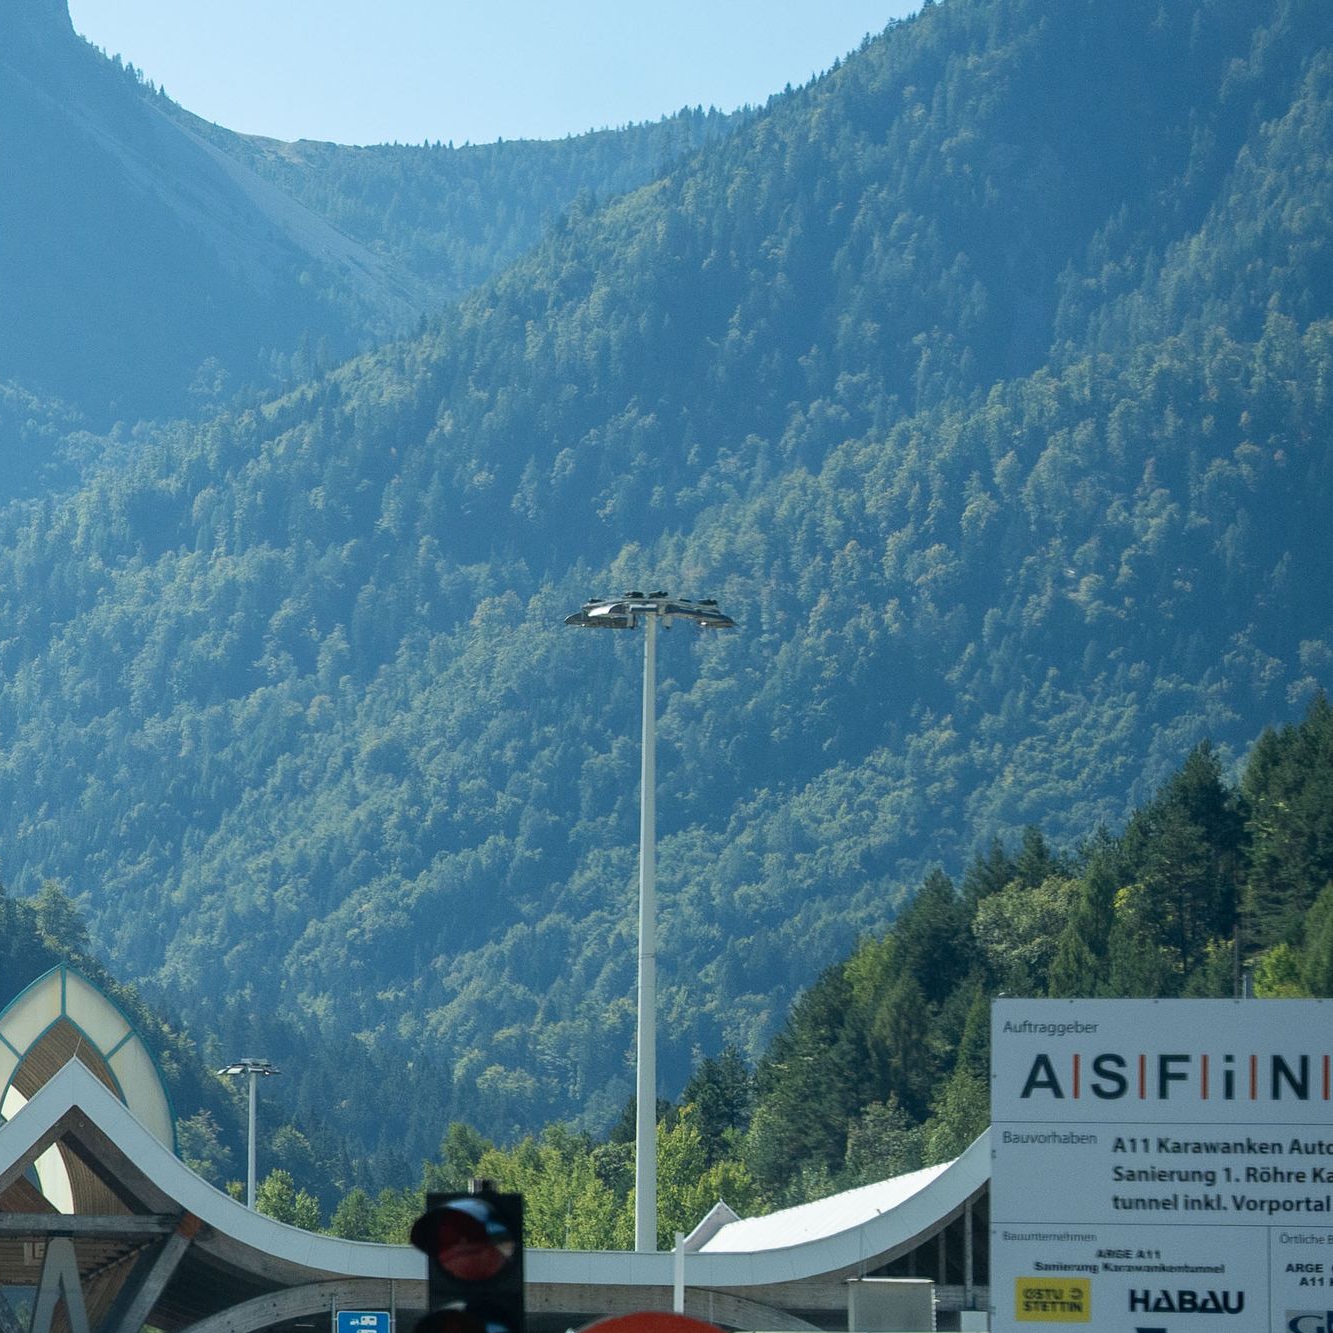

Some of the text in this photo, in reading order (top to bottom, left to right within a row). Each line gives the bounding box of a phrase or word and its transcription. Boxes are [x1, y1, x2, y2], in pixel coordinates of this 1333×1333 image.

[1003, 1020, 1099, 1036] Auftraggeber
[1002, 1131, 1098, 1144] Bauvorhaben
[1112, 1137, 1150, 1153] A11
[1157, 1137, 1282, 1154] Karawanken
[1113, 1166, 1216, 1187] Sanierung
[1224, 1167, 1240, 1182] 1.
[1245, 1167, 1306, 1183] Röhre
[1112, 1194, 1331, 1215] tunnel inkl. Vorportal
[1002, 1231, 1098, 1242] Bauunternehmen
[1279, 1232, 1325, 1245] Örtliche
[1096, 1249, 1161, 1260] ARGE A11
[1034, 1261, 1226, 1274] Sanierung Karawankentunnel
[1285, 1263, 1324, 1273] ARGE
[1299, 1277, 1324, 1286] A11
[1023, 1301, 1084, 1312] STETTIN
[1129, 1289, 1245, 1314] HABAU
